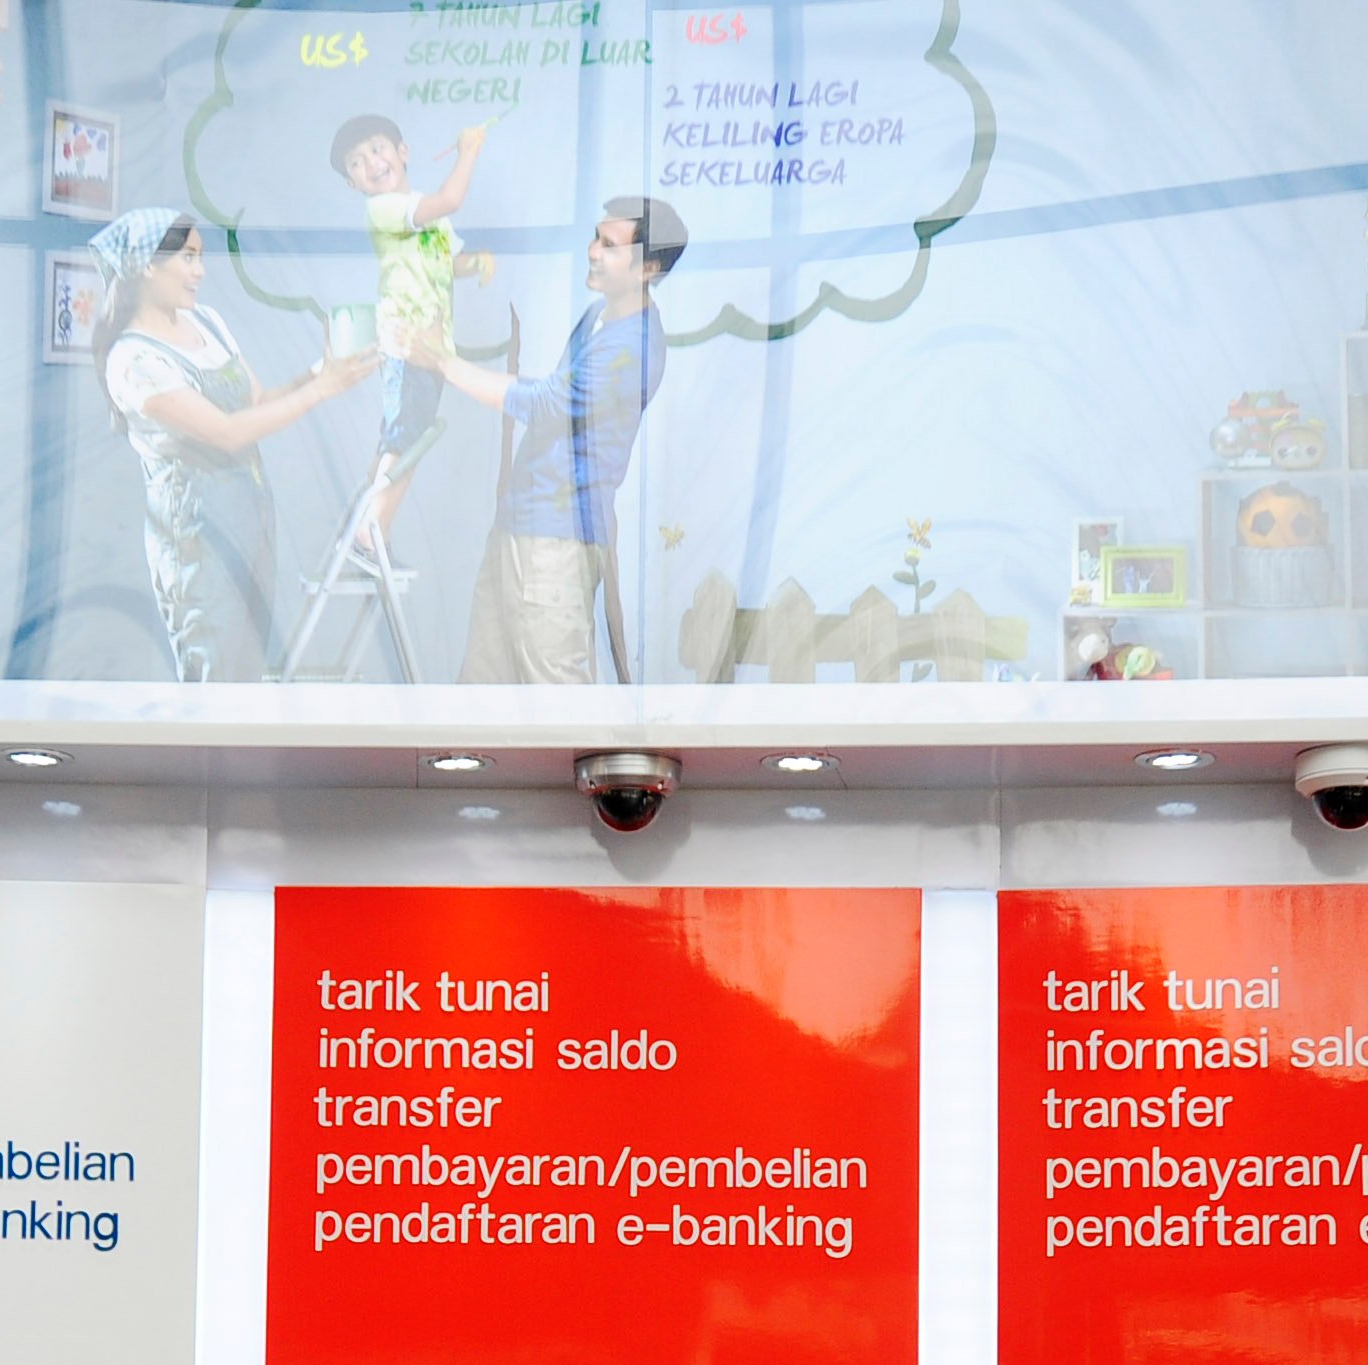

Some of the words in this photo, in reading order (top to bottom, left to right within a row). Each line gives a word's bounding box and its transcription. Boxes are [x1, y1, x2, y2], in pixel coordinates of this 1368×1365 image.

[435, 1, 520, 30] TAHUN
[530, 0, 601, 28] LAGI
[685, 14, 748, 45] US$
[300, 32, 369, 68] US$
[404, 40, 530, 66] SEKOLAH
[540, 40, 570, 66] DI
[581, 40, 653, 66] LUAR
[406, 78, 521, 106] NEGERI
[663, 82, 684, 109] 2
[692, 82, 778, 110] TAHUN
[787, 81, 858, 108] LAGI
[663, 120, 808, 148] KELILING
[819, 120, 905, 148] EROPA
[660, 160, 847, 187] SEKELUARGA
[317, 969, 421, 1011] tarik
[437, 971, 550, 1013] tunai
[1044, 969, 1145, 1012] tarik
[1163, 966, 1280, 1010] tunai
[319, 1028, 534, 1070] informasi
[557, 1030, 678, 1071] saldo
[1046, 1027, 1269, 1071] informasi
[314, 1087, 502, 1128] transfer
[1043, 1087, 1234, 1128] transfer
[316, 1144, 867, 1198] pembayaran/pembelian
[314, 1203, 595, 1251] pendaftaran
[617, 1205, 853, 1259] e-banking
[1046, 1206, 1337, 1256] pendaftaran
